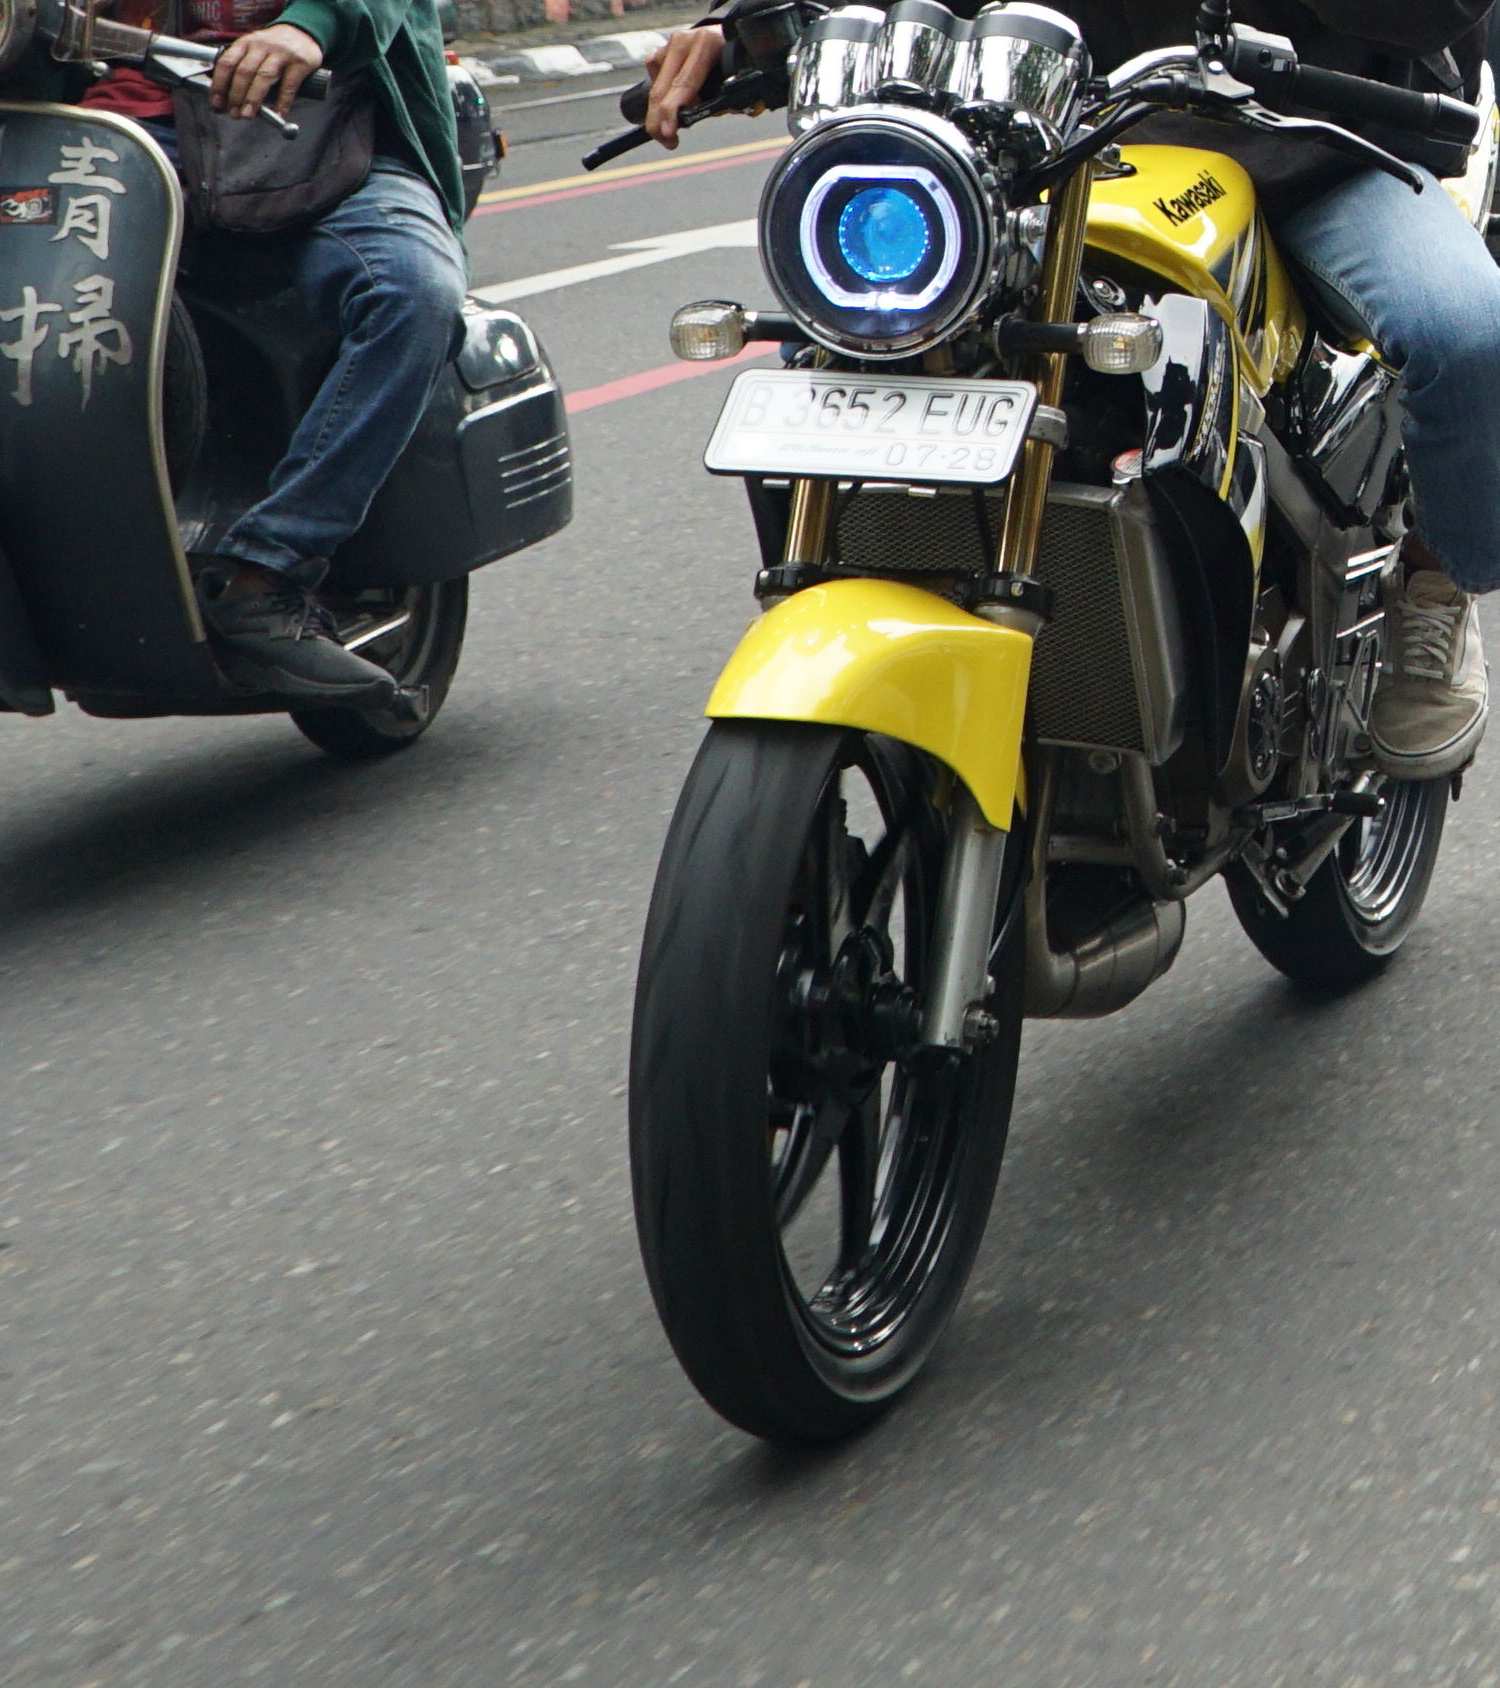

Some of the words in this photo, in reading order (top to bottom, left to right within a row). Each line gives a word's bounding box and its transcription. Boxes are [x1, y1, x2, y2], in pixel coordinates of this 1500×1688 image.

[1152, 169, 1228, 227] Kawasaki
[740, 383, 773, 427] B
[782, 386, 907, 434] 3652
[916, 391, 1015, 438] EUG
